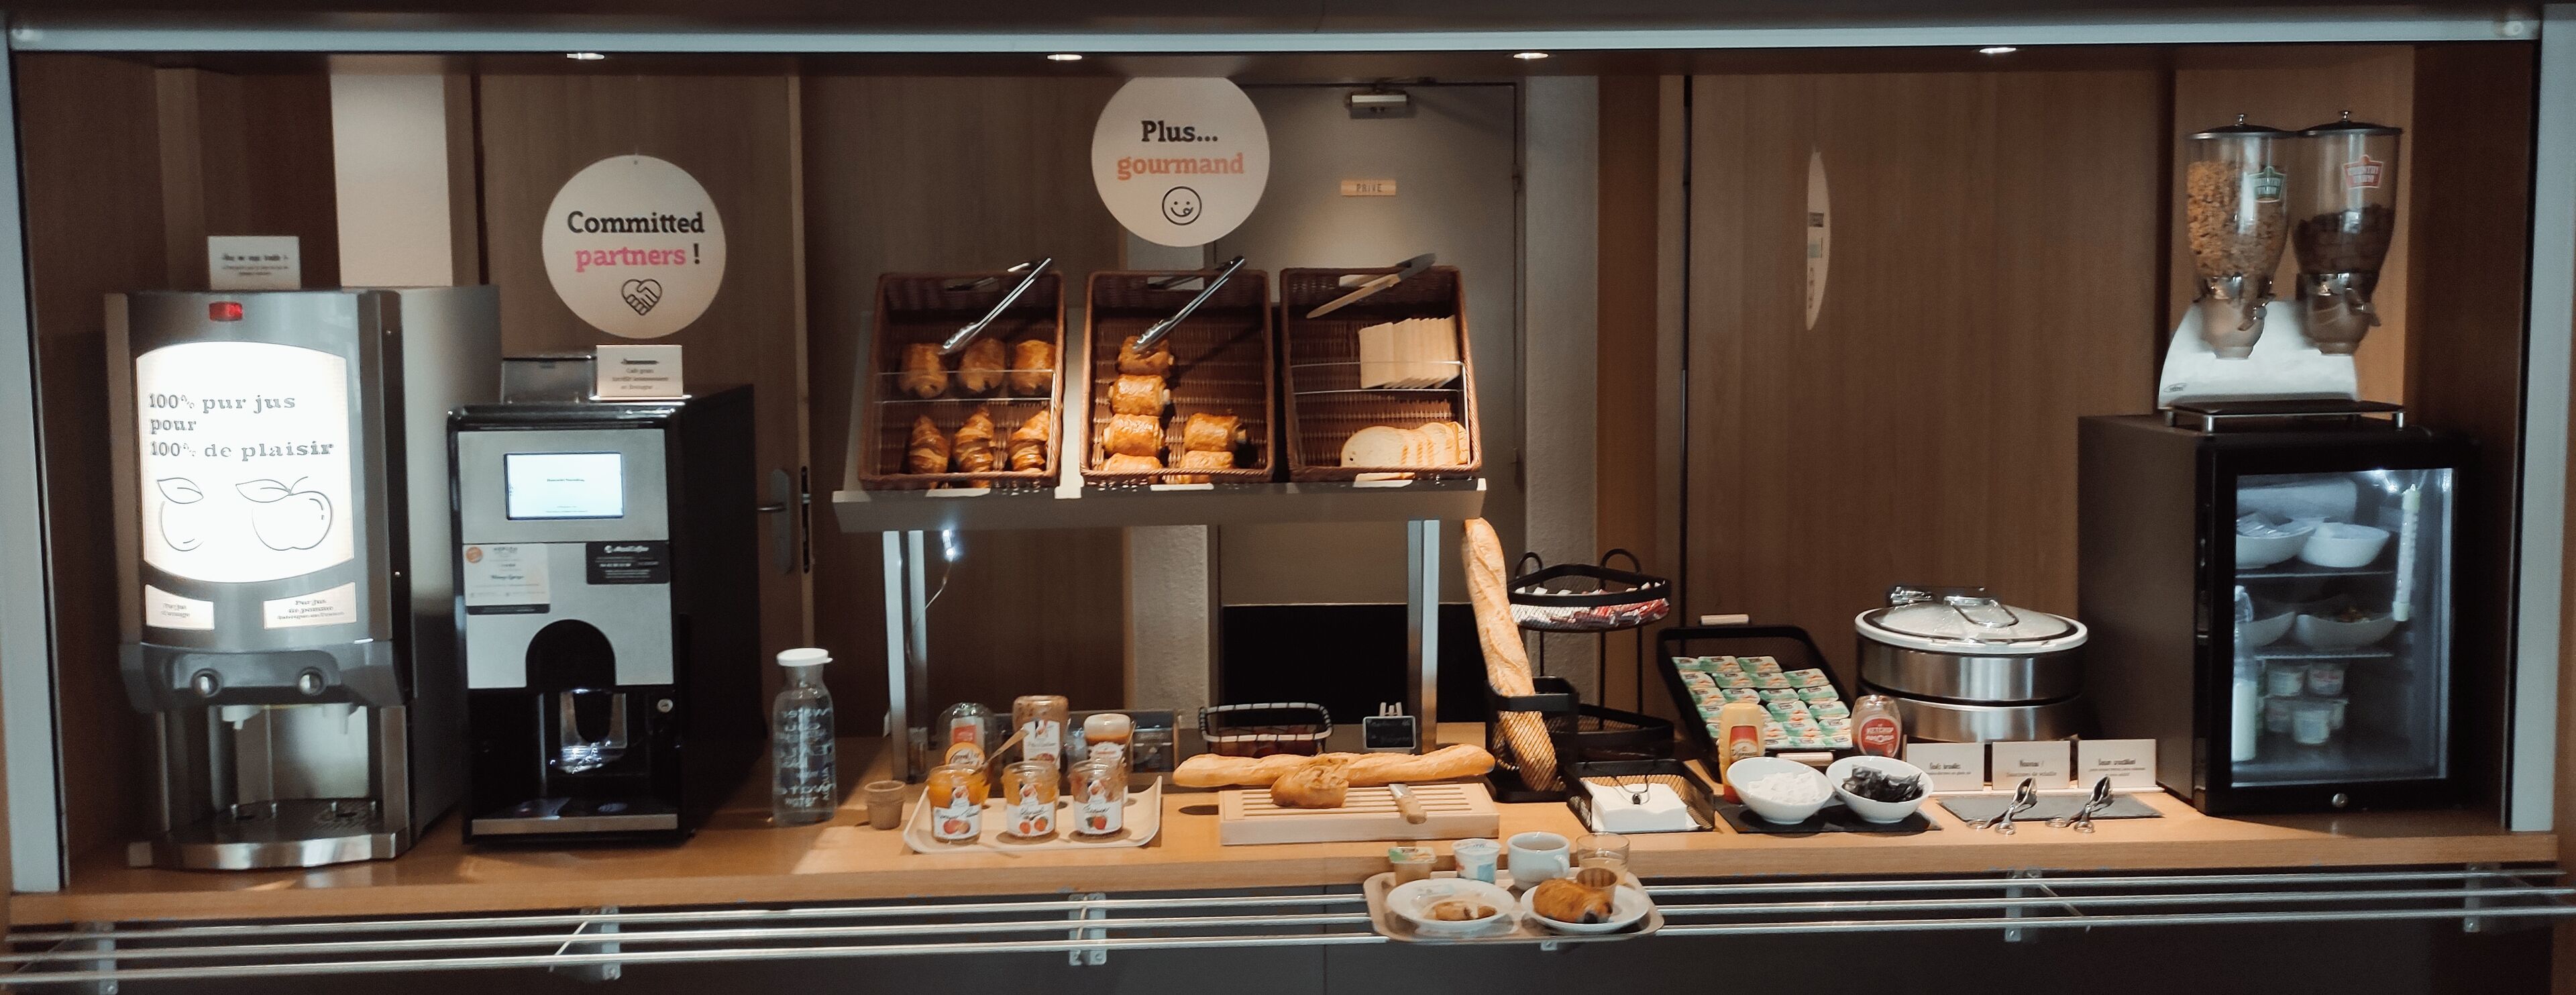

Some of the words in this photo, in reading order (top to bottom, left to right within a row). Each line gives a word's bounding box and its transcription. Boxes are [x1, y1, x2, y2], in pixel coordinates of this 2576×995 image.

[1141, 120, 1218, 142] Plus...
[1117, 152, 1244, 180] gourmand
[568, 211, 705, 233] Committed
[576, 246, 686, 272] partners
[693, 243, 700, 264] !
[202, 397, 246, 414] pur
[253, 395, 296, 414] jus
[150, 418, 197, 435] pour
[204, 443, 232, 458] de
[241, 440, 335, 462] plaisir
